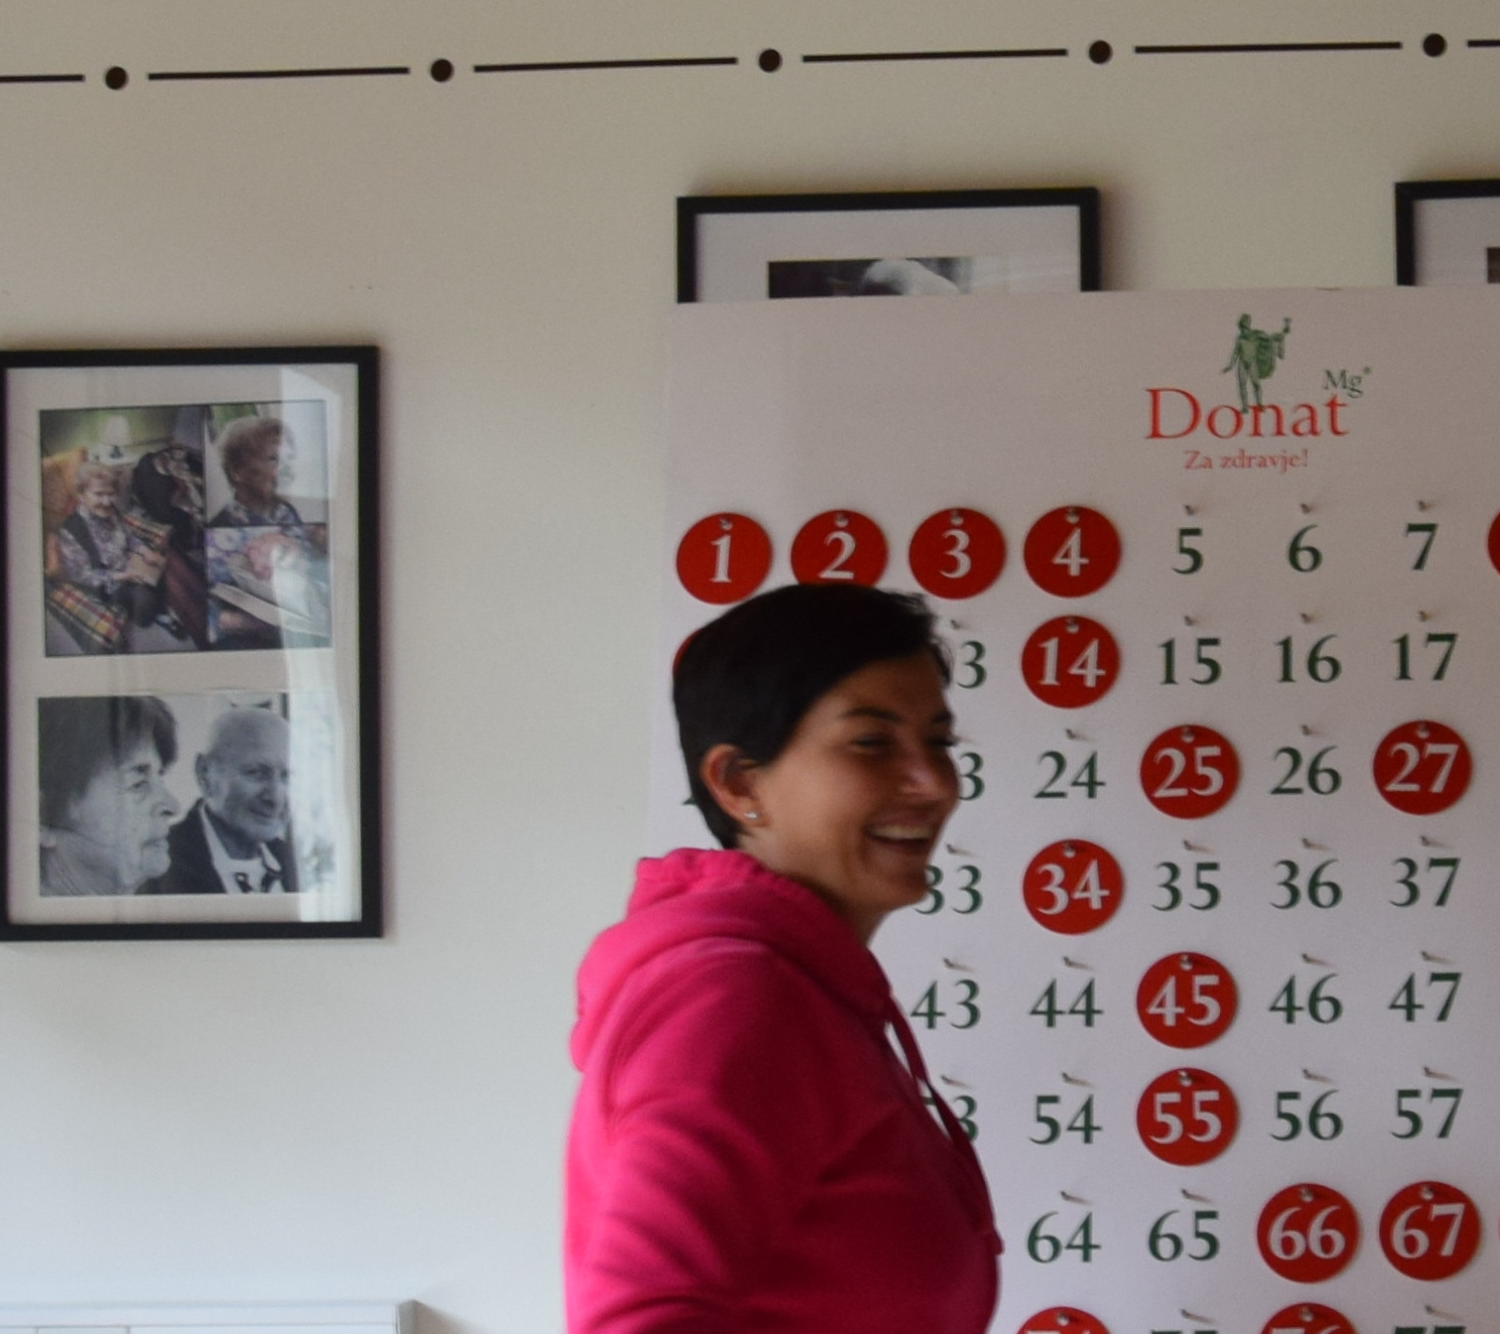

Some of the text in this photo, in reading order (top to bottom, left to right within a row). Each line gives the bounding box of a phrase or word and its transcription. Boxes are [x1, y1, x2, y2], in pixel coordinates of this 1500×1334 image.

[1145, 388, 1350, 440] Donat
[1183, 449, 1309, 474] Za zdravje!
[709, 533, 732, 584] 1
[819, 530, 856, 580] 2
[941, 528, 972, 579] 3
[1052, 528, 1090, 577] 4
[1174, 527, 1203, 575] 5
[1288, 526, 1323, 573] 6
[1406, 522, 1438, 571] 7
[956, 639, 987, 690] 3
[1040, 637, 1106, 688] 14
[1158, 637, 1221, 685] 15
[1275, 636, 1342, 683] 16
[1392, 632, 1458, 681] 17
[957, 751, 986, 802] 3
[1034, 750, 1106, 799] 24
[1153, 745, 1224, 798] 25
[1270, 746, 1342, 795] 26
[1385, 742, 1459, 793] 27
[1038, 860, 1110, 915] 34
[1152, 861, 1221, 912] 35
[1271, 859, 1343, 910] 36
[1389, 857, 1460, 907] 37
[910, 979, 982, 1030] 43
[1029, 979, 1103, 1028] 44
[1147, 974, 1221, 1027] 45
[1269, 975, 1343, 1025] 46
[1388, 972, 1462, 1022] 47
[1031, 1095, 1102, 1145] 54
[1150, 1090, 1222, 1145] 55
[1272, 1091, 1343, 1142] 56
[1392, 1088, 1463, 1139] 57
[1027, 1212, 1101, 1264] 64
[1148, 1210, 1220, 1262] 65
[1268, 1206, 1346, 1261] 66
[1391, 1202, 1465, 1259] 67
